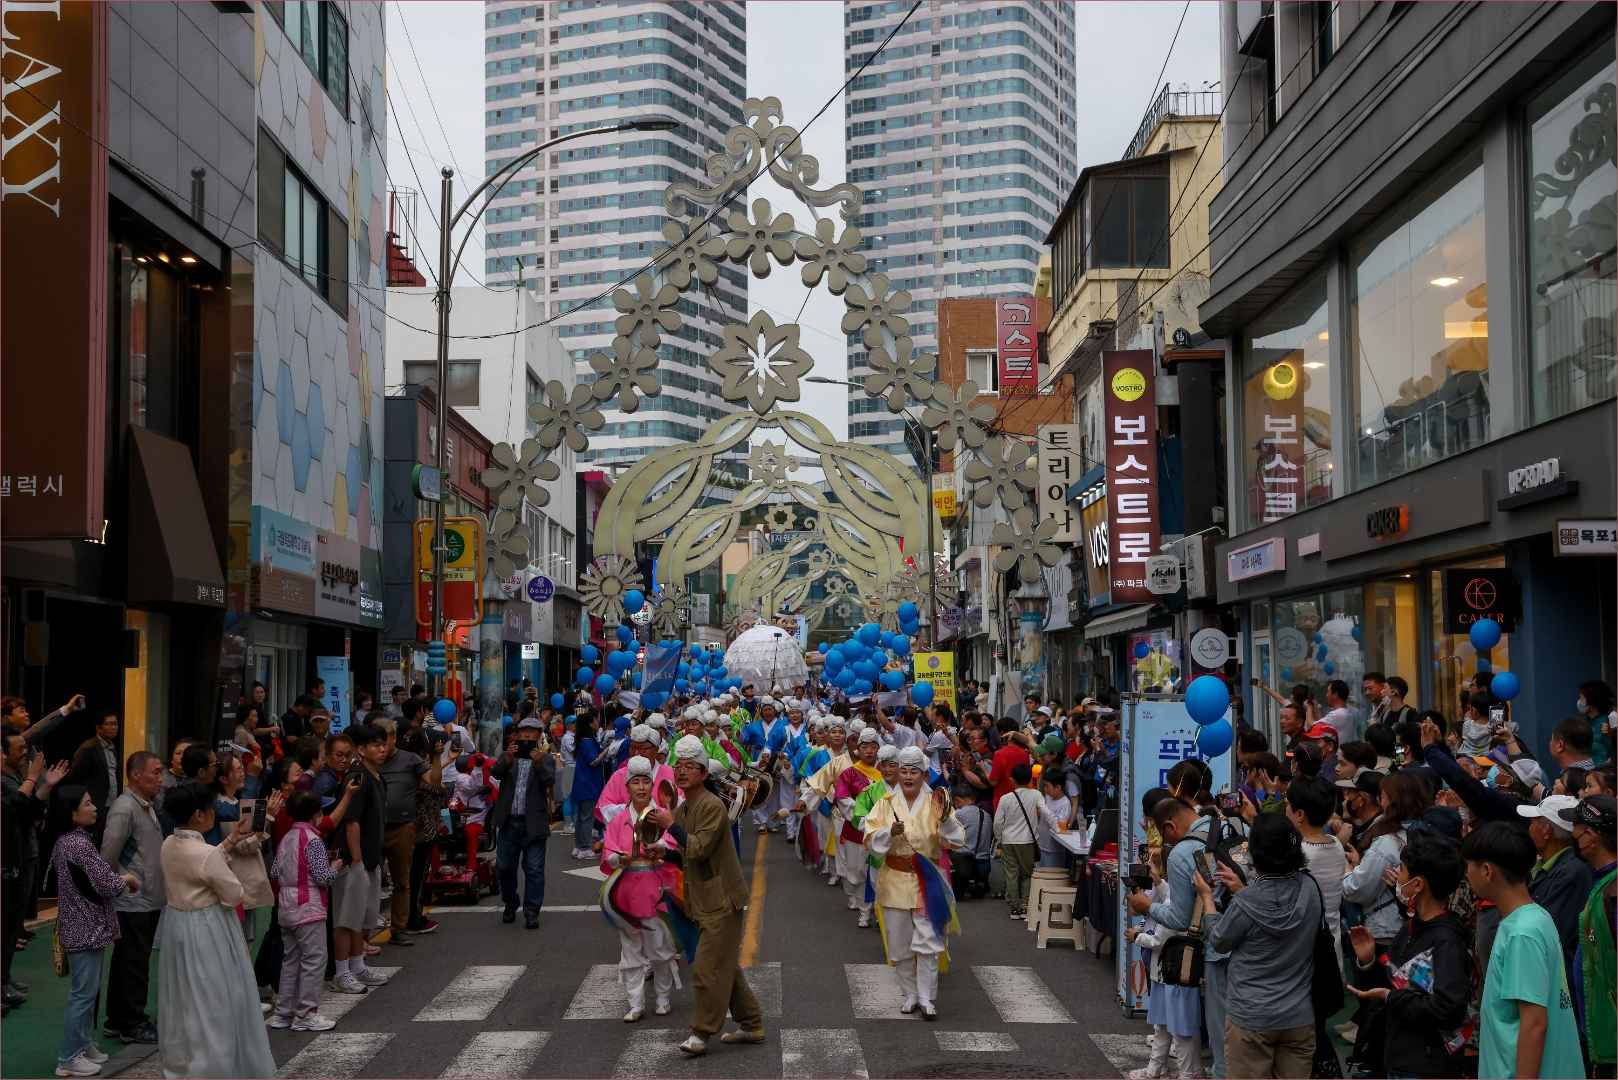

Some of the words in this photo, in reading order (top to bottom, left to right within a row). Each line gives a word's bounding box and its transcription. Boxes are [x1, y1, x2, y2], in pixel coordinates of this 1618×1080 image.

[1003, 303, 1032, 379] 고스트
[1116, 384, 1143, 392] VOSTRO
[1114, 415, 1152, 564] 보스트로
[1152, 566, 1176, 578] Asahi
[1127, 579, 1148, 588] 파크
